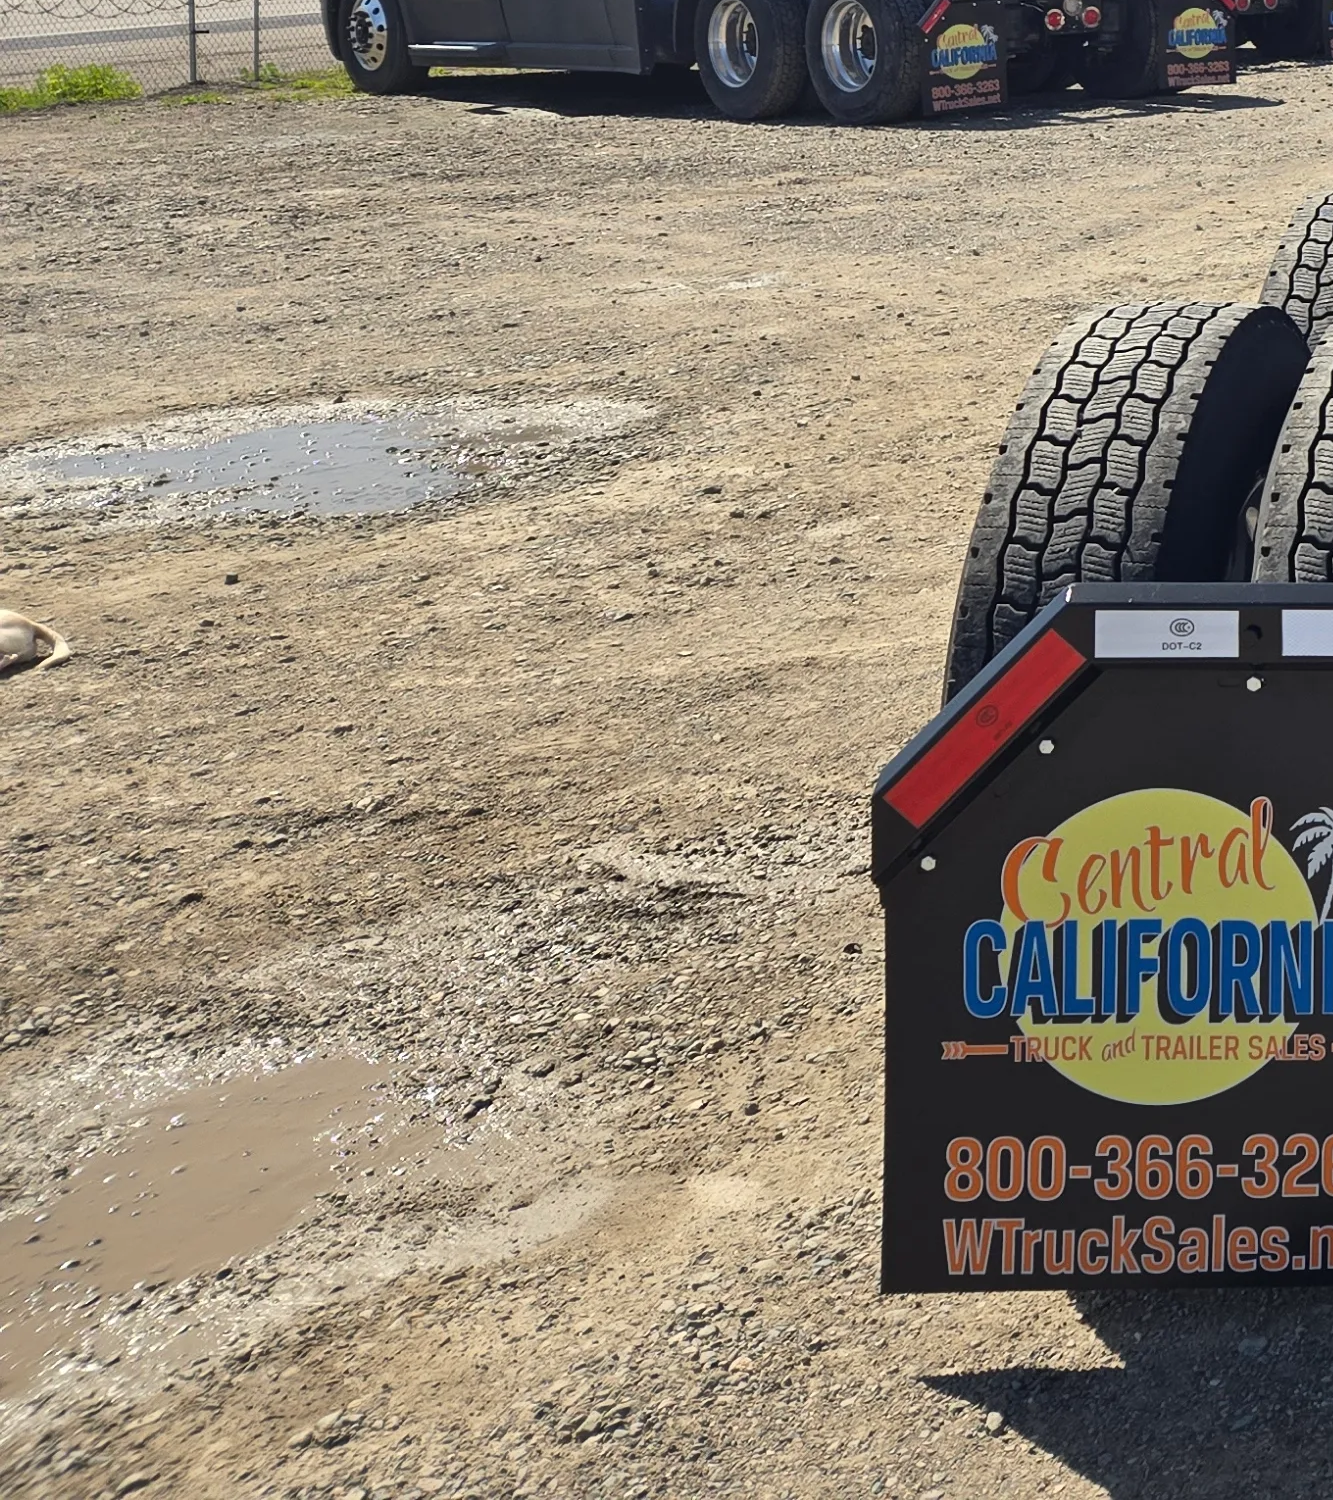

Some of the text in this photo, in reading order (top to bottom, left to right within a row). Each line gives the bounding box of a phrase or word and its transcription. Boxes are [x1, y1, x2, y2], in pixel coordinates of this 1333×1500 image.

[1161, 642, 1203, 651] DOT-C2
[1001, 796, 1275, 928] Central
[1010, 1028, 1326, 1063] TRUCK and TRAILER SALES
